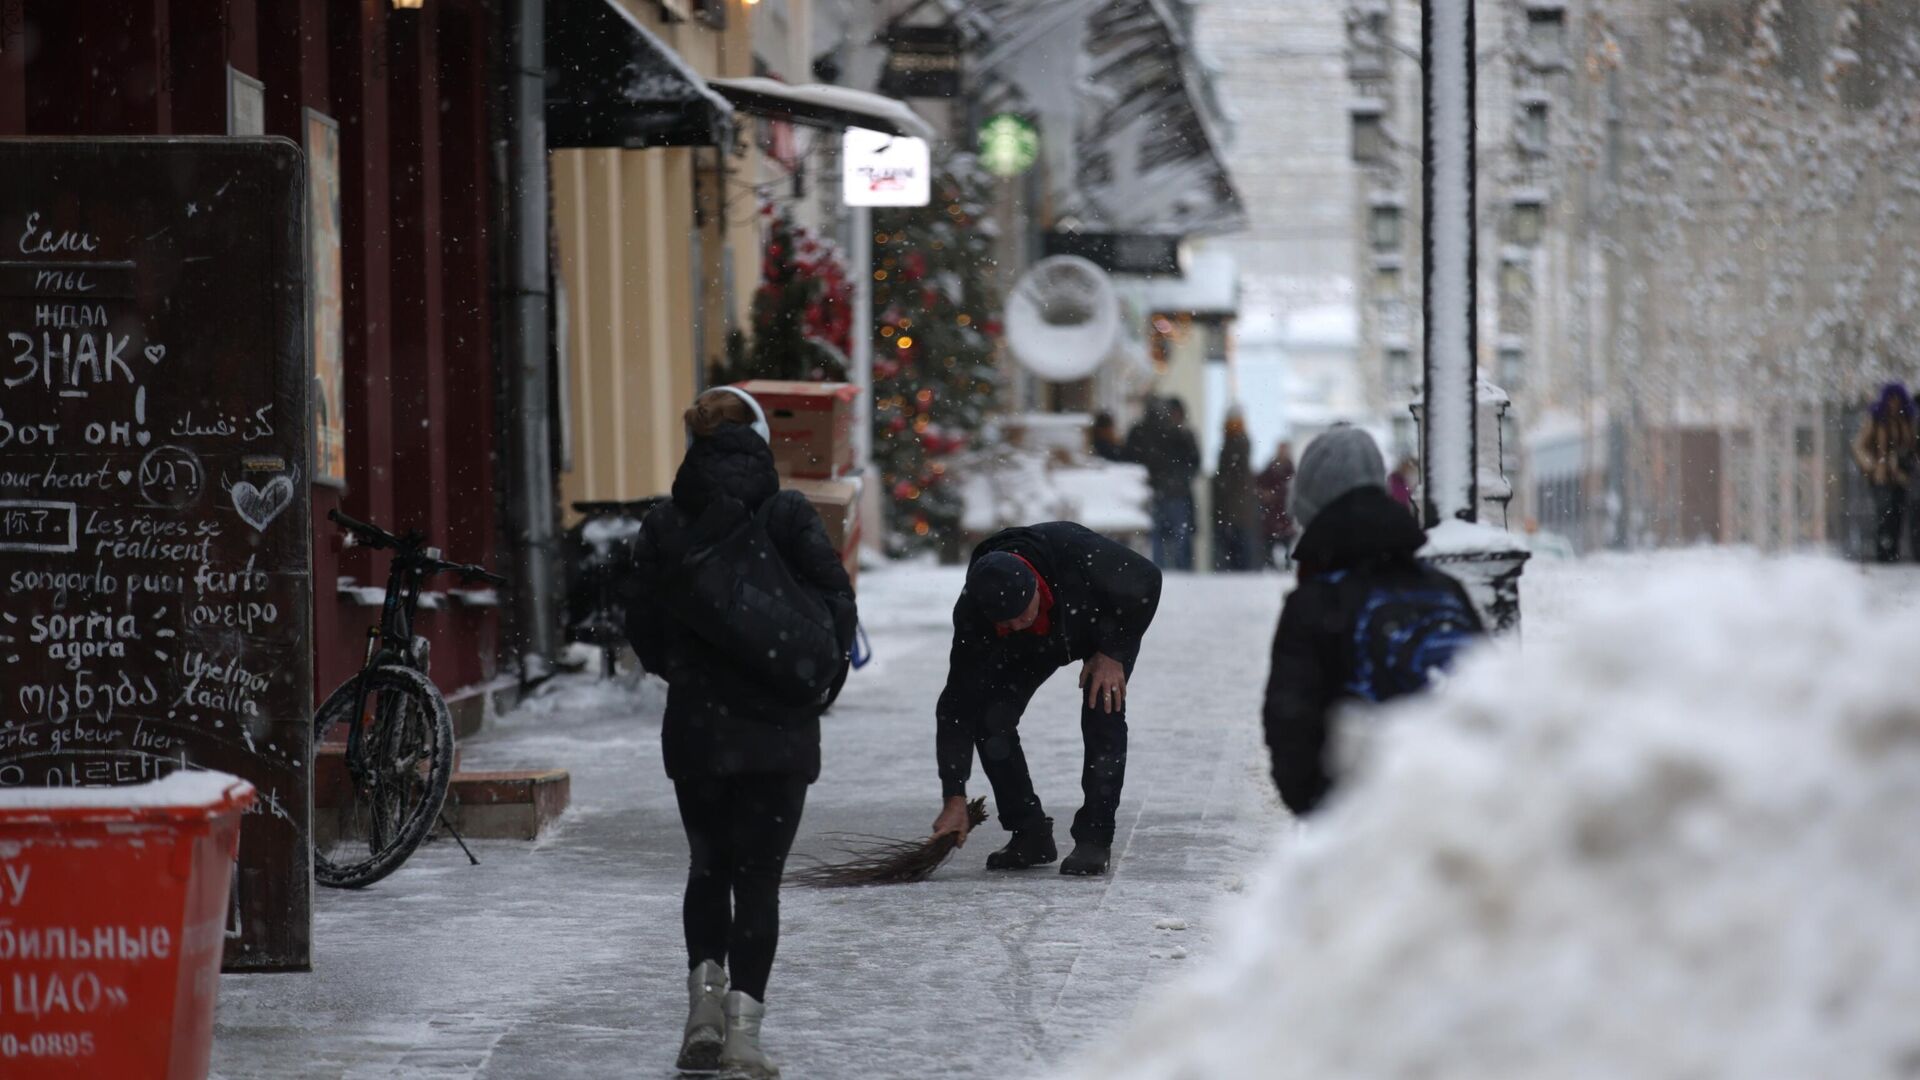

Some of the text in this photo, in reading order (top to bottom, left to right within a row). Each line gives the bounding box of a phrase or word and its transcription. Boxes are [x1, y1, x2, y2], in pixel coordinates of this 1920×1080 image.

[19, 211, 97, 254] Если
[35, 270, 97, 291] ты
[4, 331, 136, 392] ЗНАК
[170, 403, 275, 441] كن نفسك
[42, 457, 112, 490] heart
[85, 510, 223, 536] Les rêves se
[95, 535, 211, 562] réalisent
[126, 567, 184, 608] puoi
[30, 606, 142, 643] sorria
[48, 641, 126, 670] agora
[19, 670, 158, 724] ოცნება
[50, 718, 123, 754] gebeur
[12, 970, 129, 1021] ЦАО»
